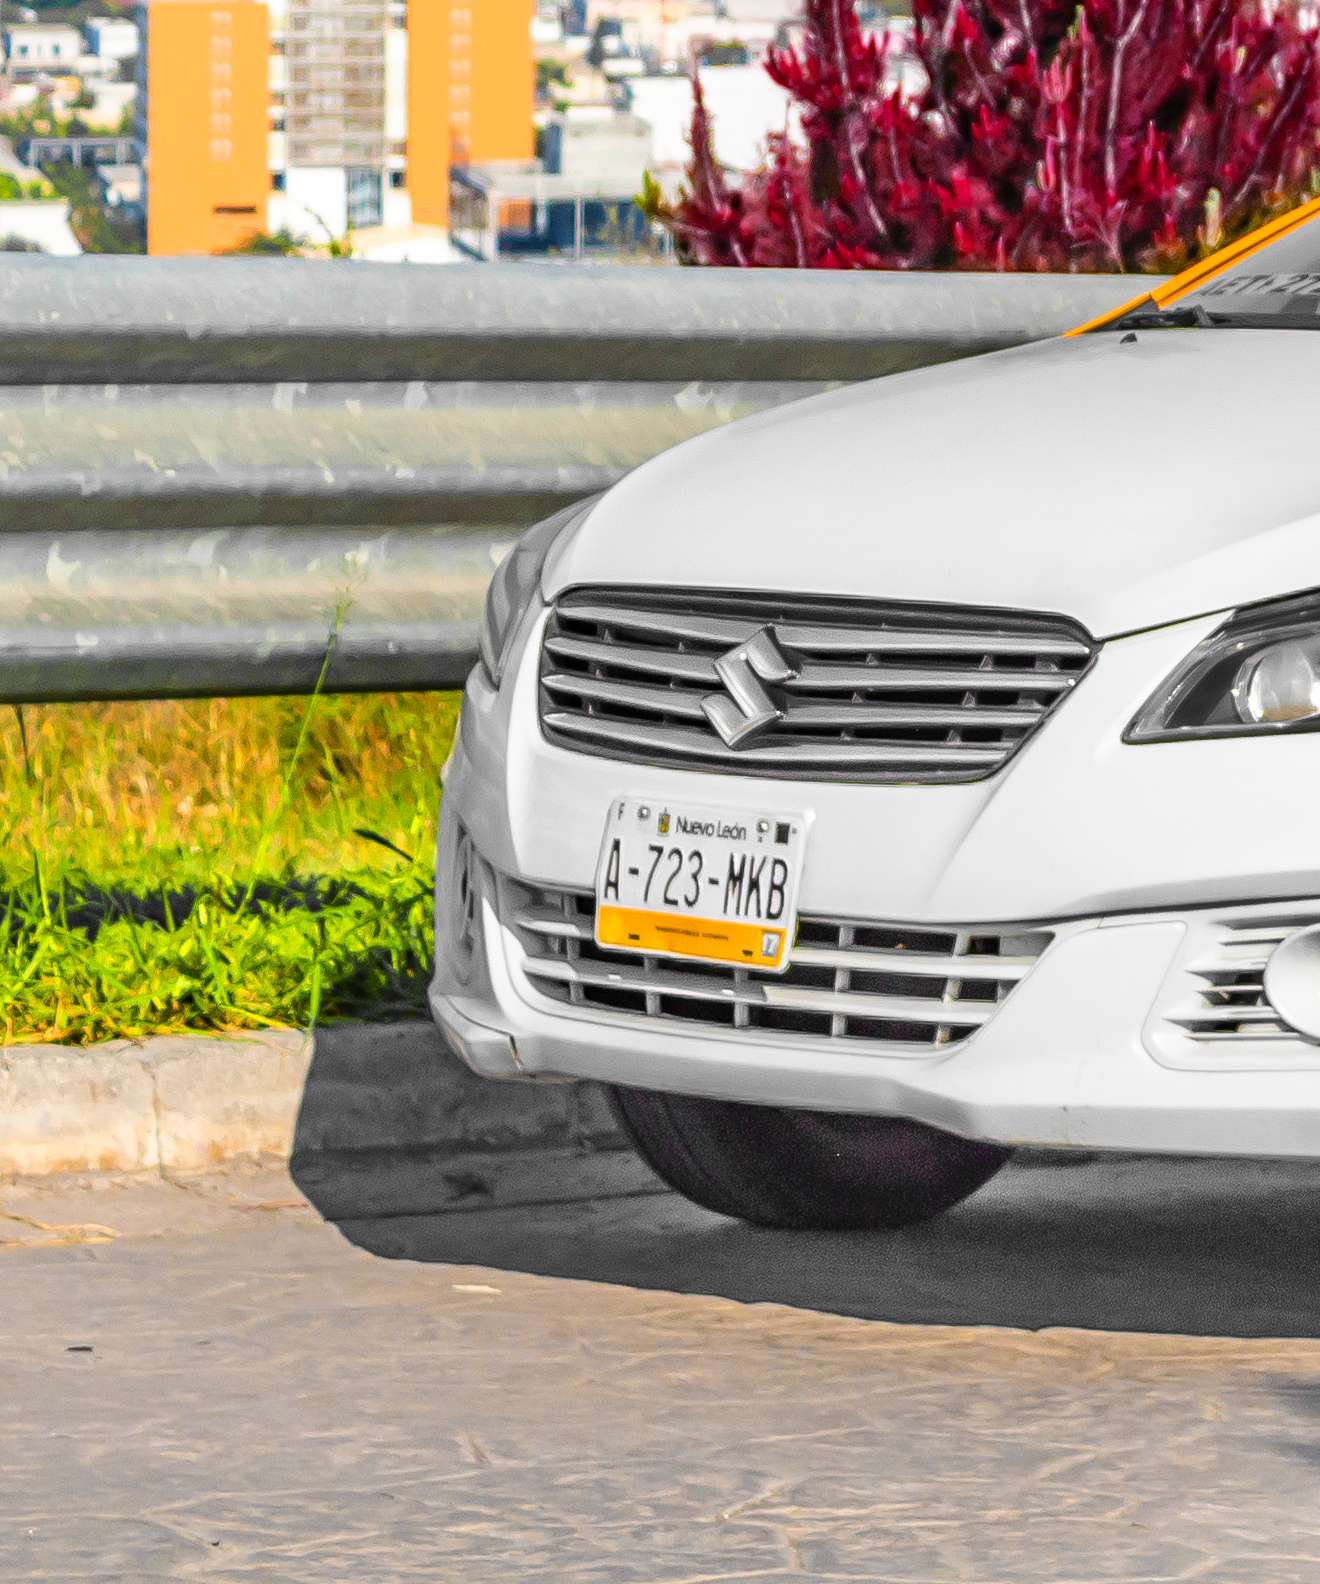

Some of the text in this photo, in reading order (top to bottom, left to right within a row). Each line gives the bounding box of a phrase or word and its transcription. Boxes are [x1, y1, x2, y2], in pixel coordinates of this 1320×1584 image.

[676, 815, 747, 841] Nuevo León
[604, 838, 788, 921] A-723-MKB
